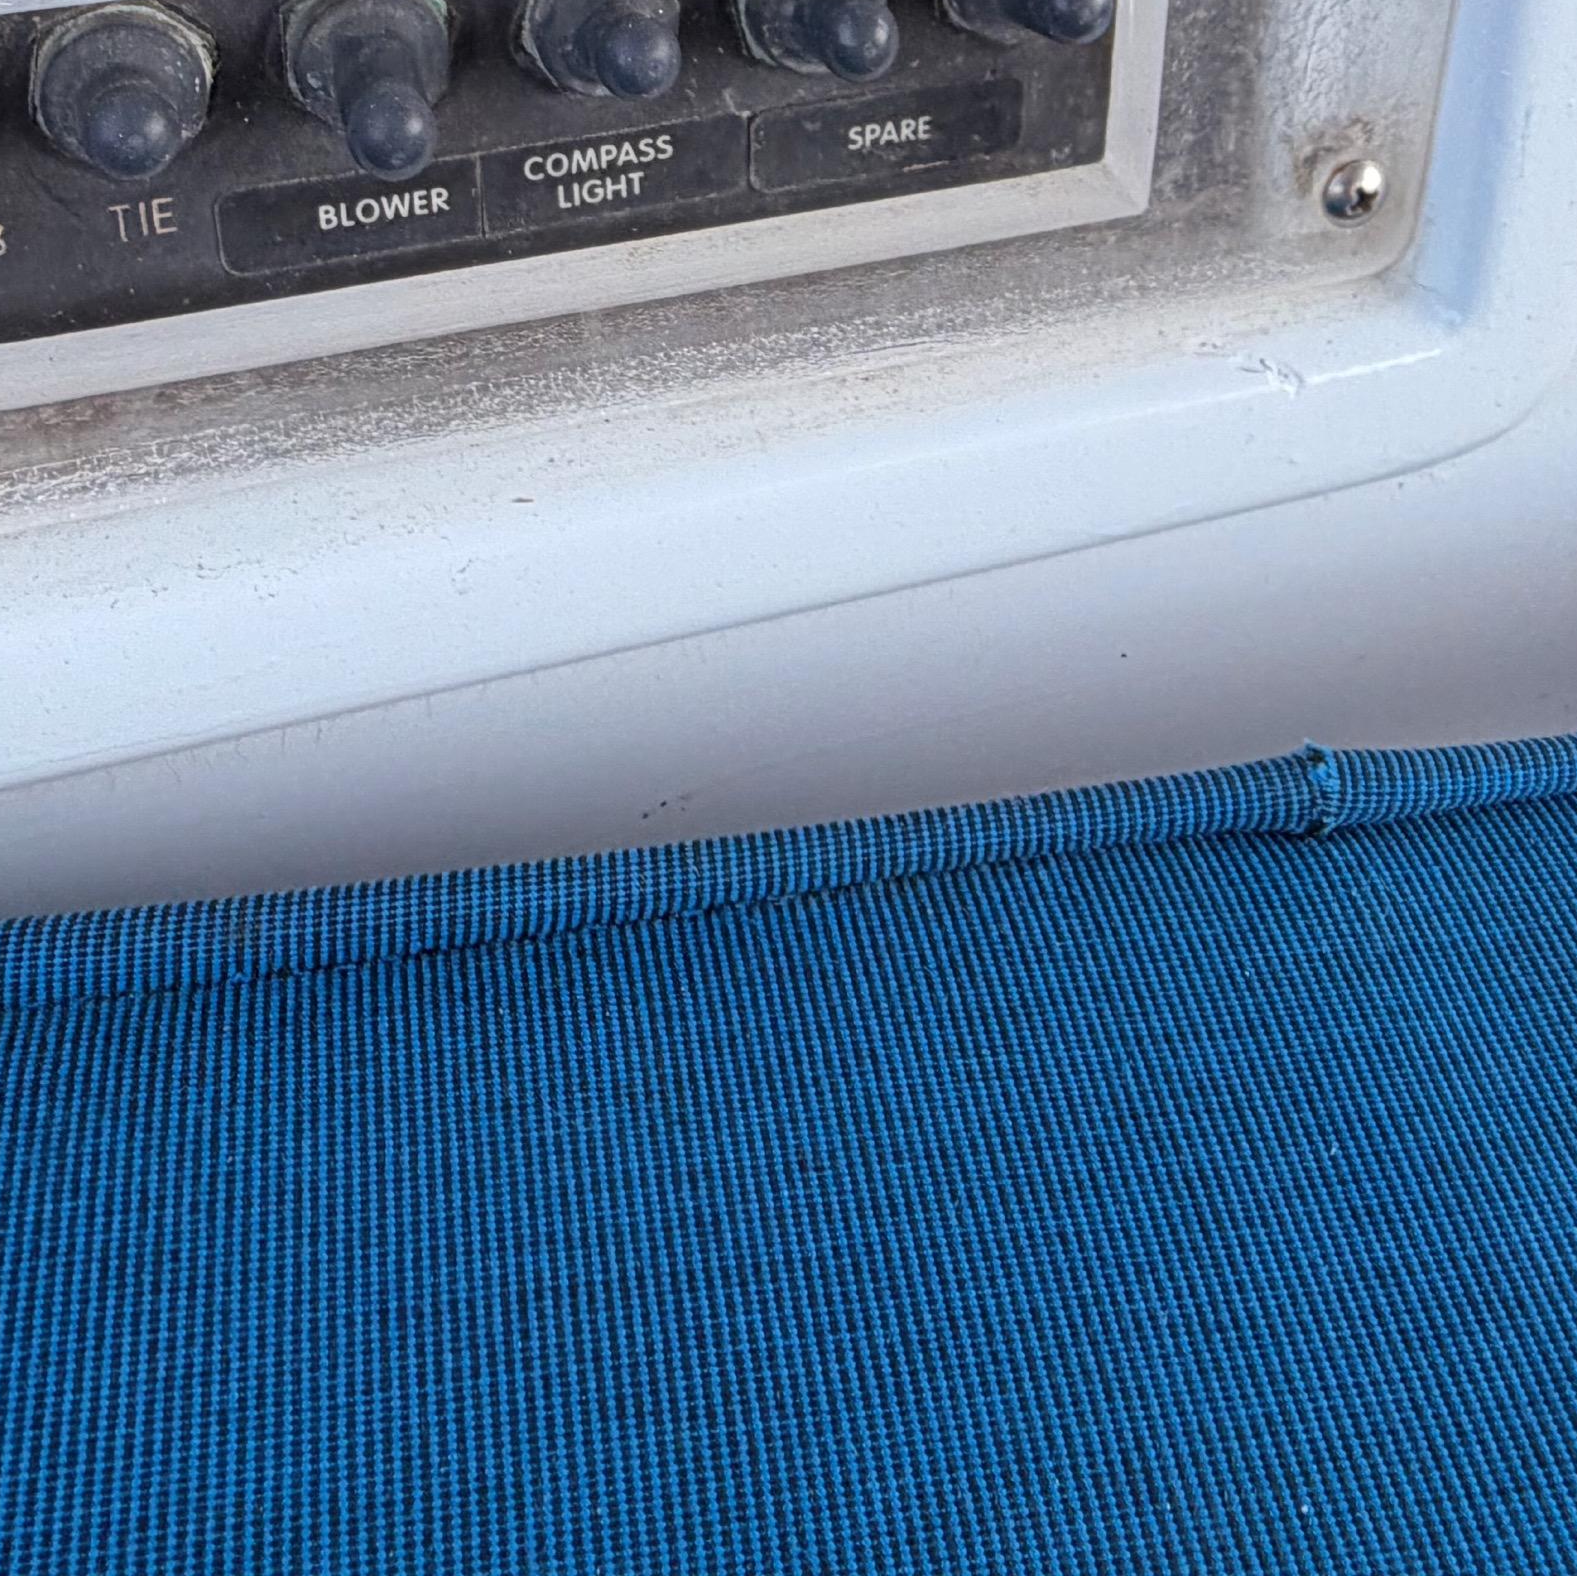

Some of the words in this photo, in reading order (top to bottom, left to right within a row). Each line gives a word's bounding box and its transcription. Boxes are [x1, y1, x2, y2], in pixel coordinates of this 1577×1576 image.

[847, 116, 933, 151] SPARE
[523, 135, 675, 182] COMPASS
[317, 187, 451, 231] BLOWER
[555, 171, 644, 210] LIGHT
[107, 196, 179, 243] TIE
